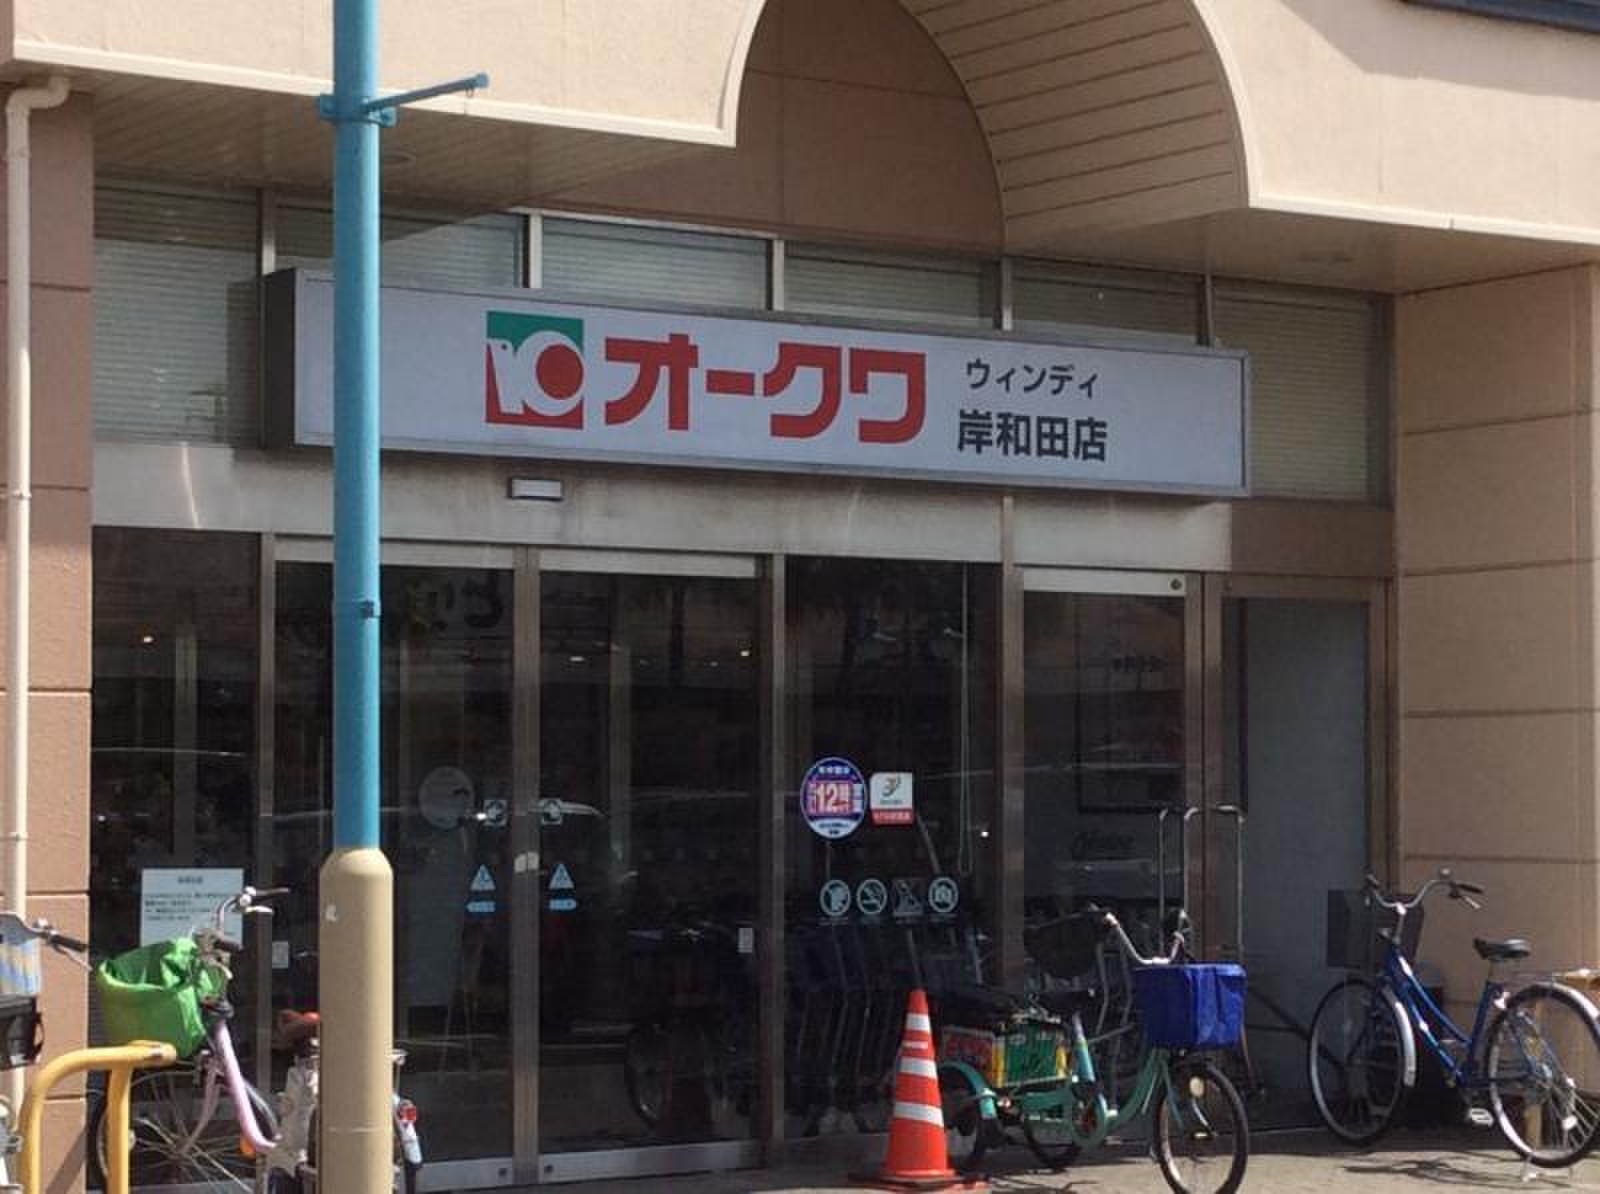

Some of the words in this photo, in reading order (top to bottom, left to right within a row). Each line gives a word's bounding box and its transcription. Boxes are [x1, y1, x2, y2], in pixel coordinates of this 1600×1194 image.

[605, 332, 927, 444] オークワ
[966, 358, 1098, 399] ウィンディ
[957, 409, 1108, 462] 岸和田店
